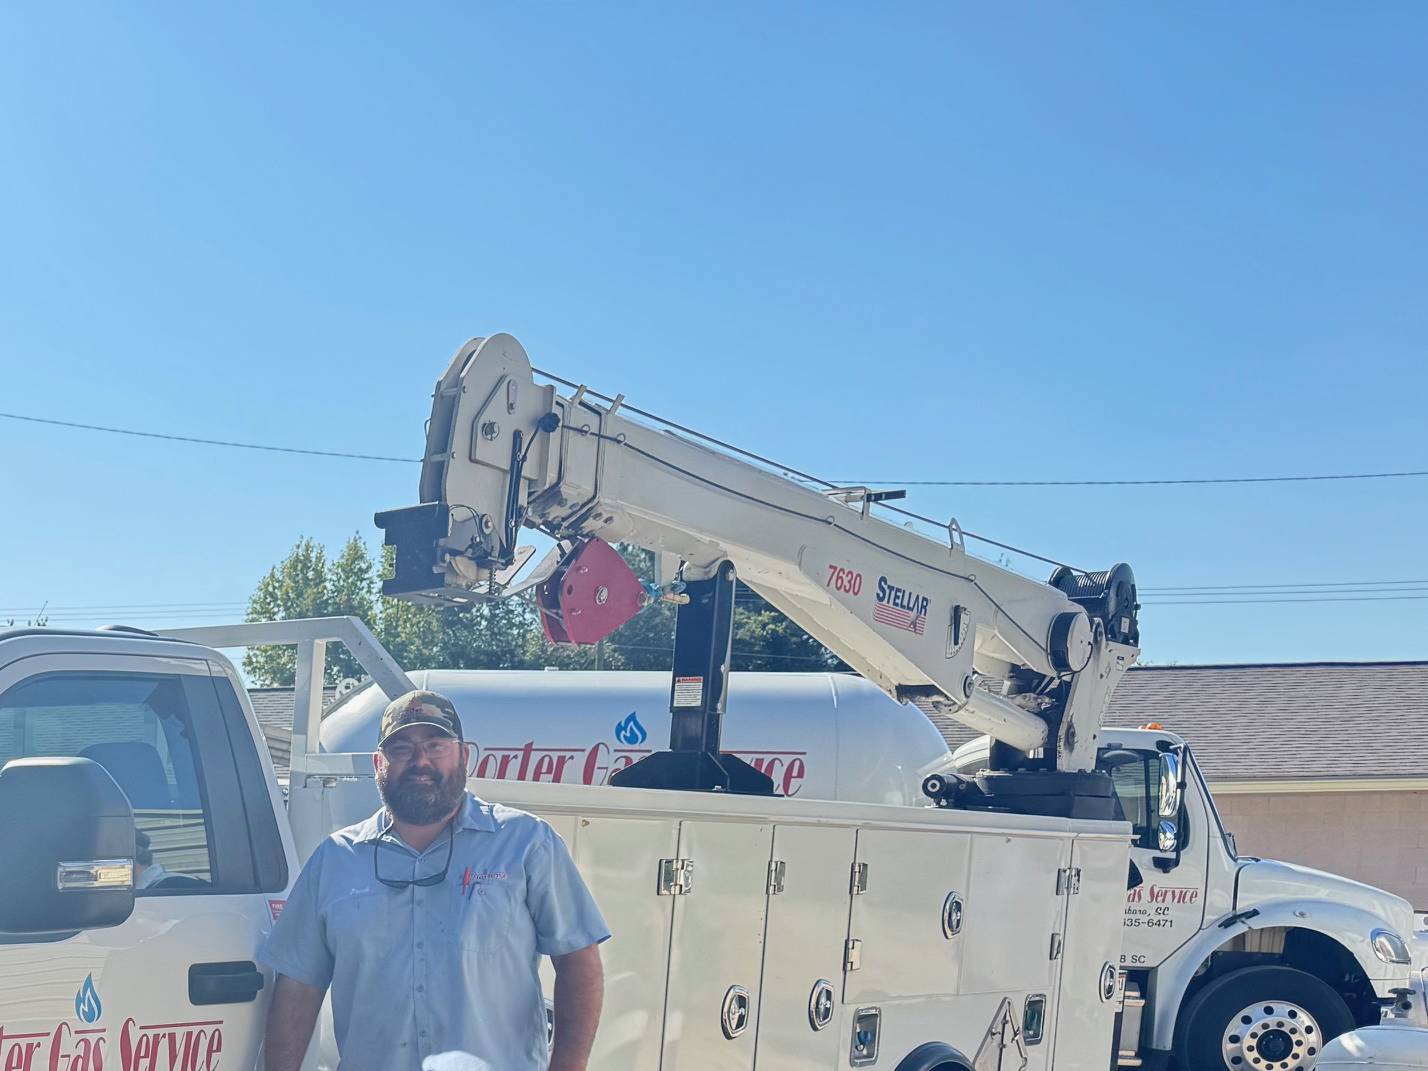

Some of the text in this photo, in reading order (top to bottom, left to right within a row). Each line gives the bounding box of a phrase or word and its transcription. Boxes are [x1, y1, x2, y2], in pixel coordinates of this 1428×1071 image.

[827, 564, 862, 596] 7630
[876, 576, 929, 616] STELLAR
[1127, 884, 1199, 904] as Service
[1154, 906, 1170, 916] SC
[1131, 954, 1146, 964] SC
